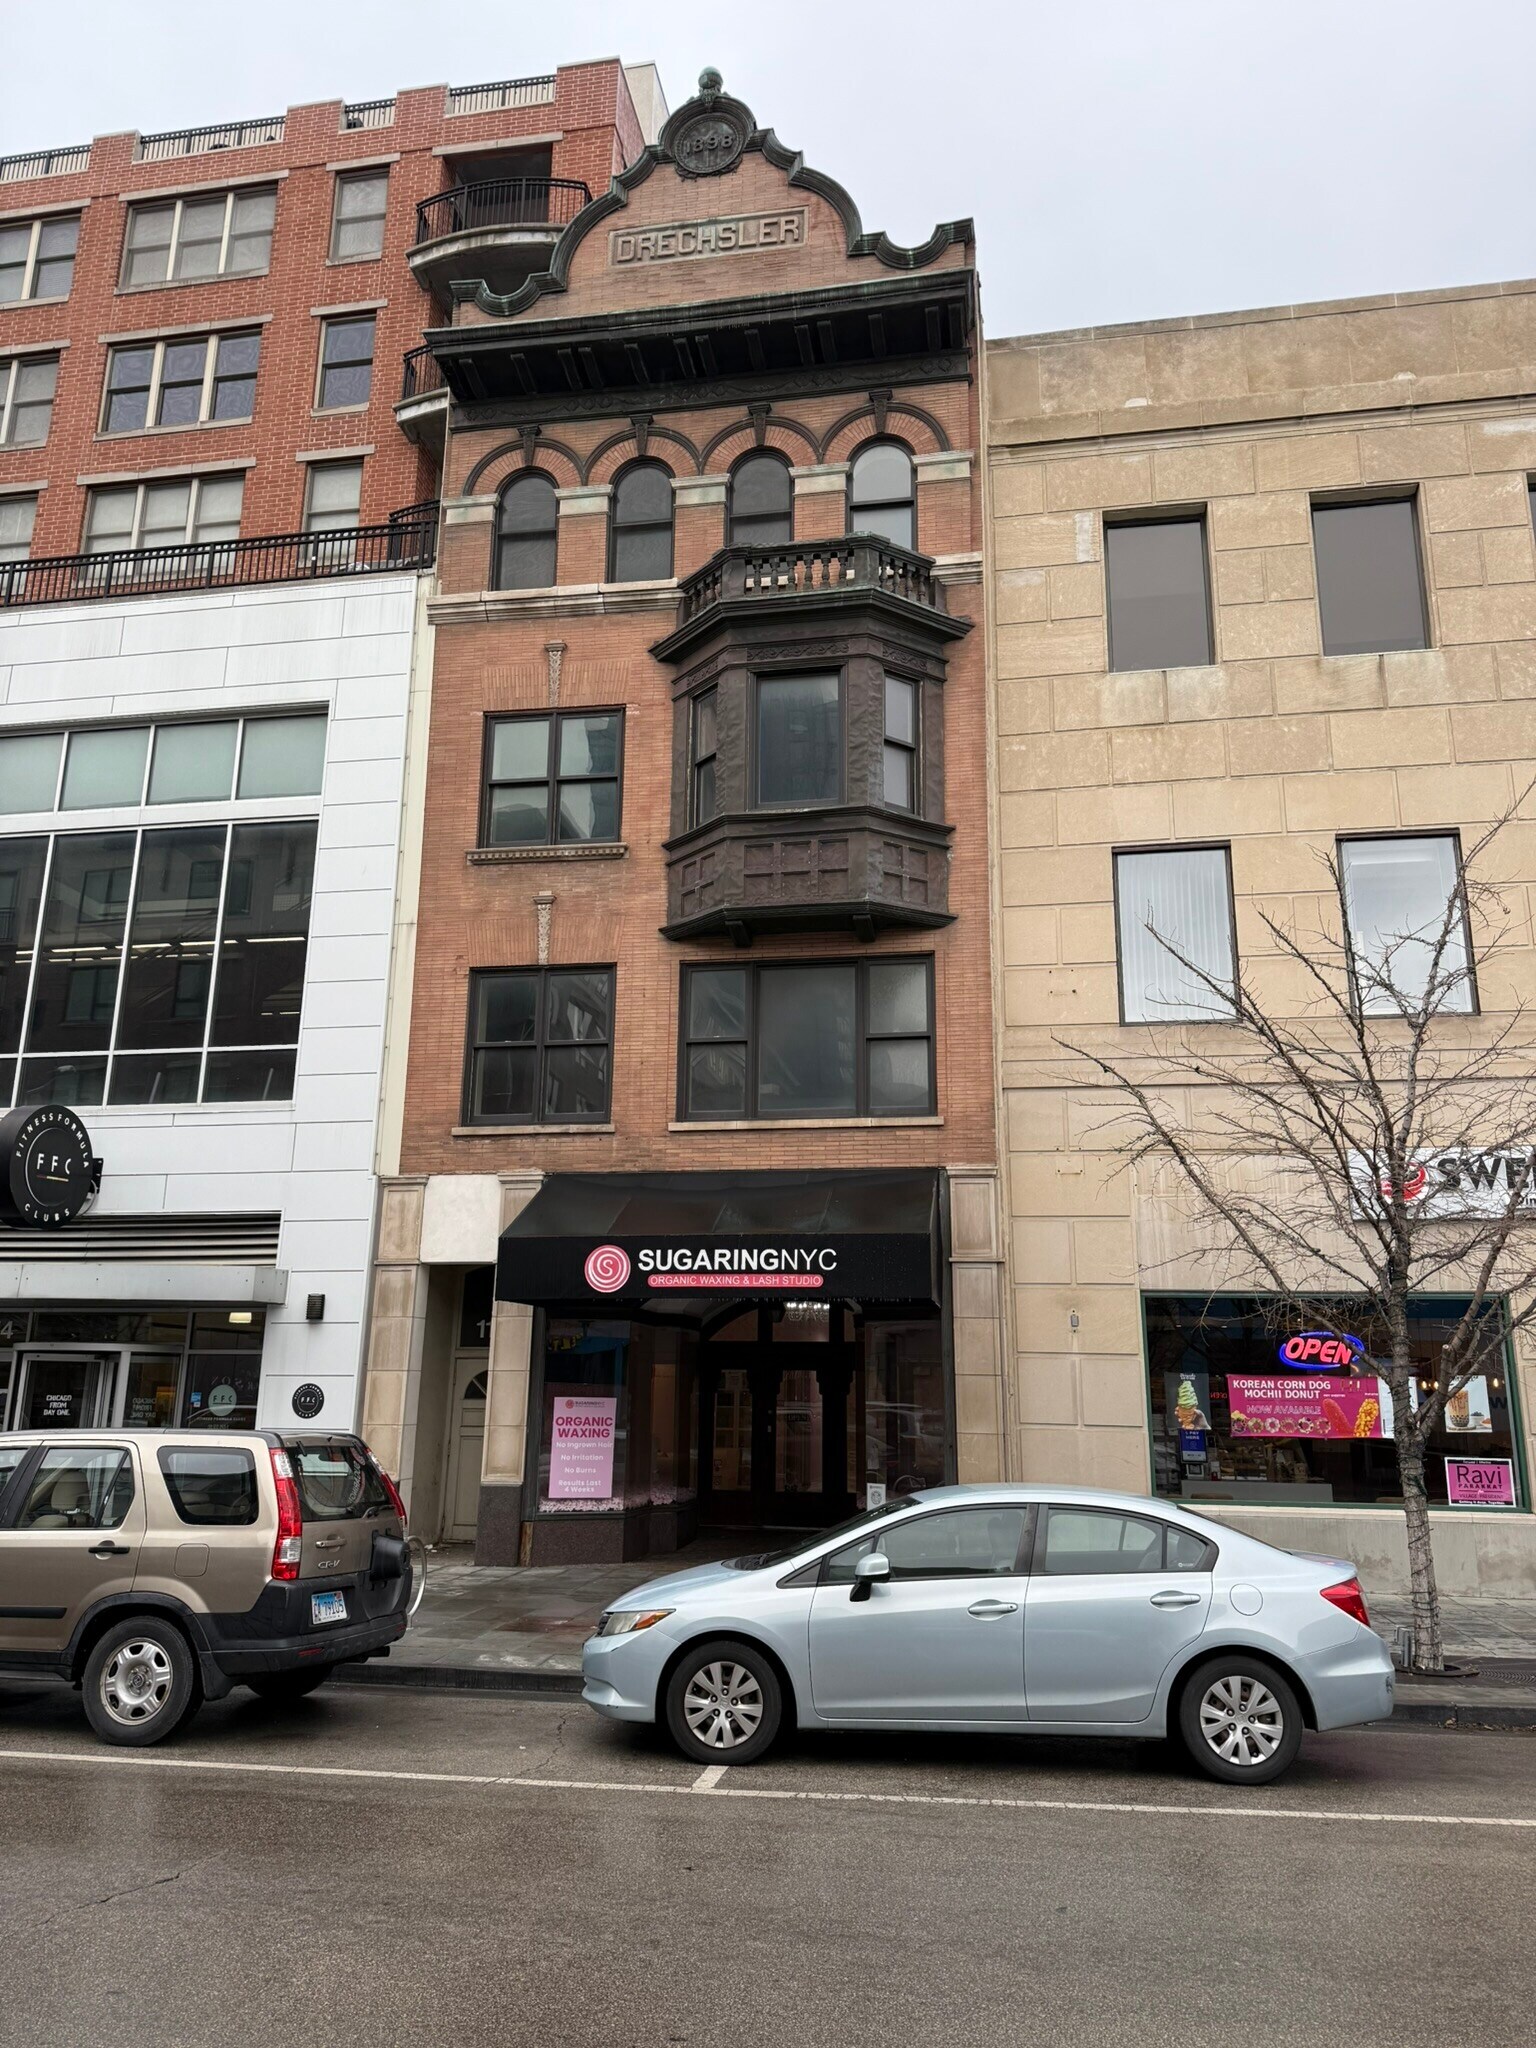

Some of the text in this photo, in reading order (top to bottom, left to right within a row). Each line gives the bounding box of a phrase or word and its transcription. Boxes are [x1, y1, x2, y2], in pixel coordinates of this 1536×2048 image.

[685, 134, 734, 155] 1898
[616, 215, 800, 263] DRECHSLER
[16, 1113, 90, 1168] FITNESS FORMULA
[1437, 1157, 1536, 1190] SWE
[24, 1203, 70, 1222] CLUBS
[638, 1248, 837, 1271] SUGARINGNYC
[650, 1276, 822, 1286] ORGANIC WAXING & LASH STUDIO
[476, 1319, 492, 1338] 1
[1285, 1337, 1352, 1364] OPEN
[1233, 1379, 1331, 1390] KOREAN CORN DOG
[1244, 1389, 1281, 1398] MOCHII
[1285, 1390, 1320, 1399] DONUT
[1246, 1405, 1272, 1414] NOW
[555, 1416, 613, 1427] ORGANIC
[557, 1428, 610, 1438] WAXING
[567, 1442, 597, 1450] Ingrown
[1456, 1465, 1502, 1484] Ravi
